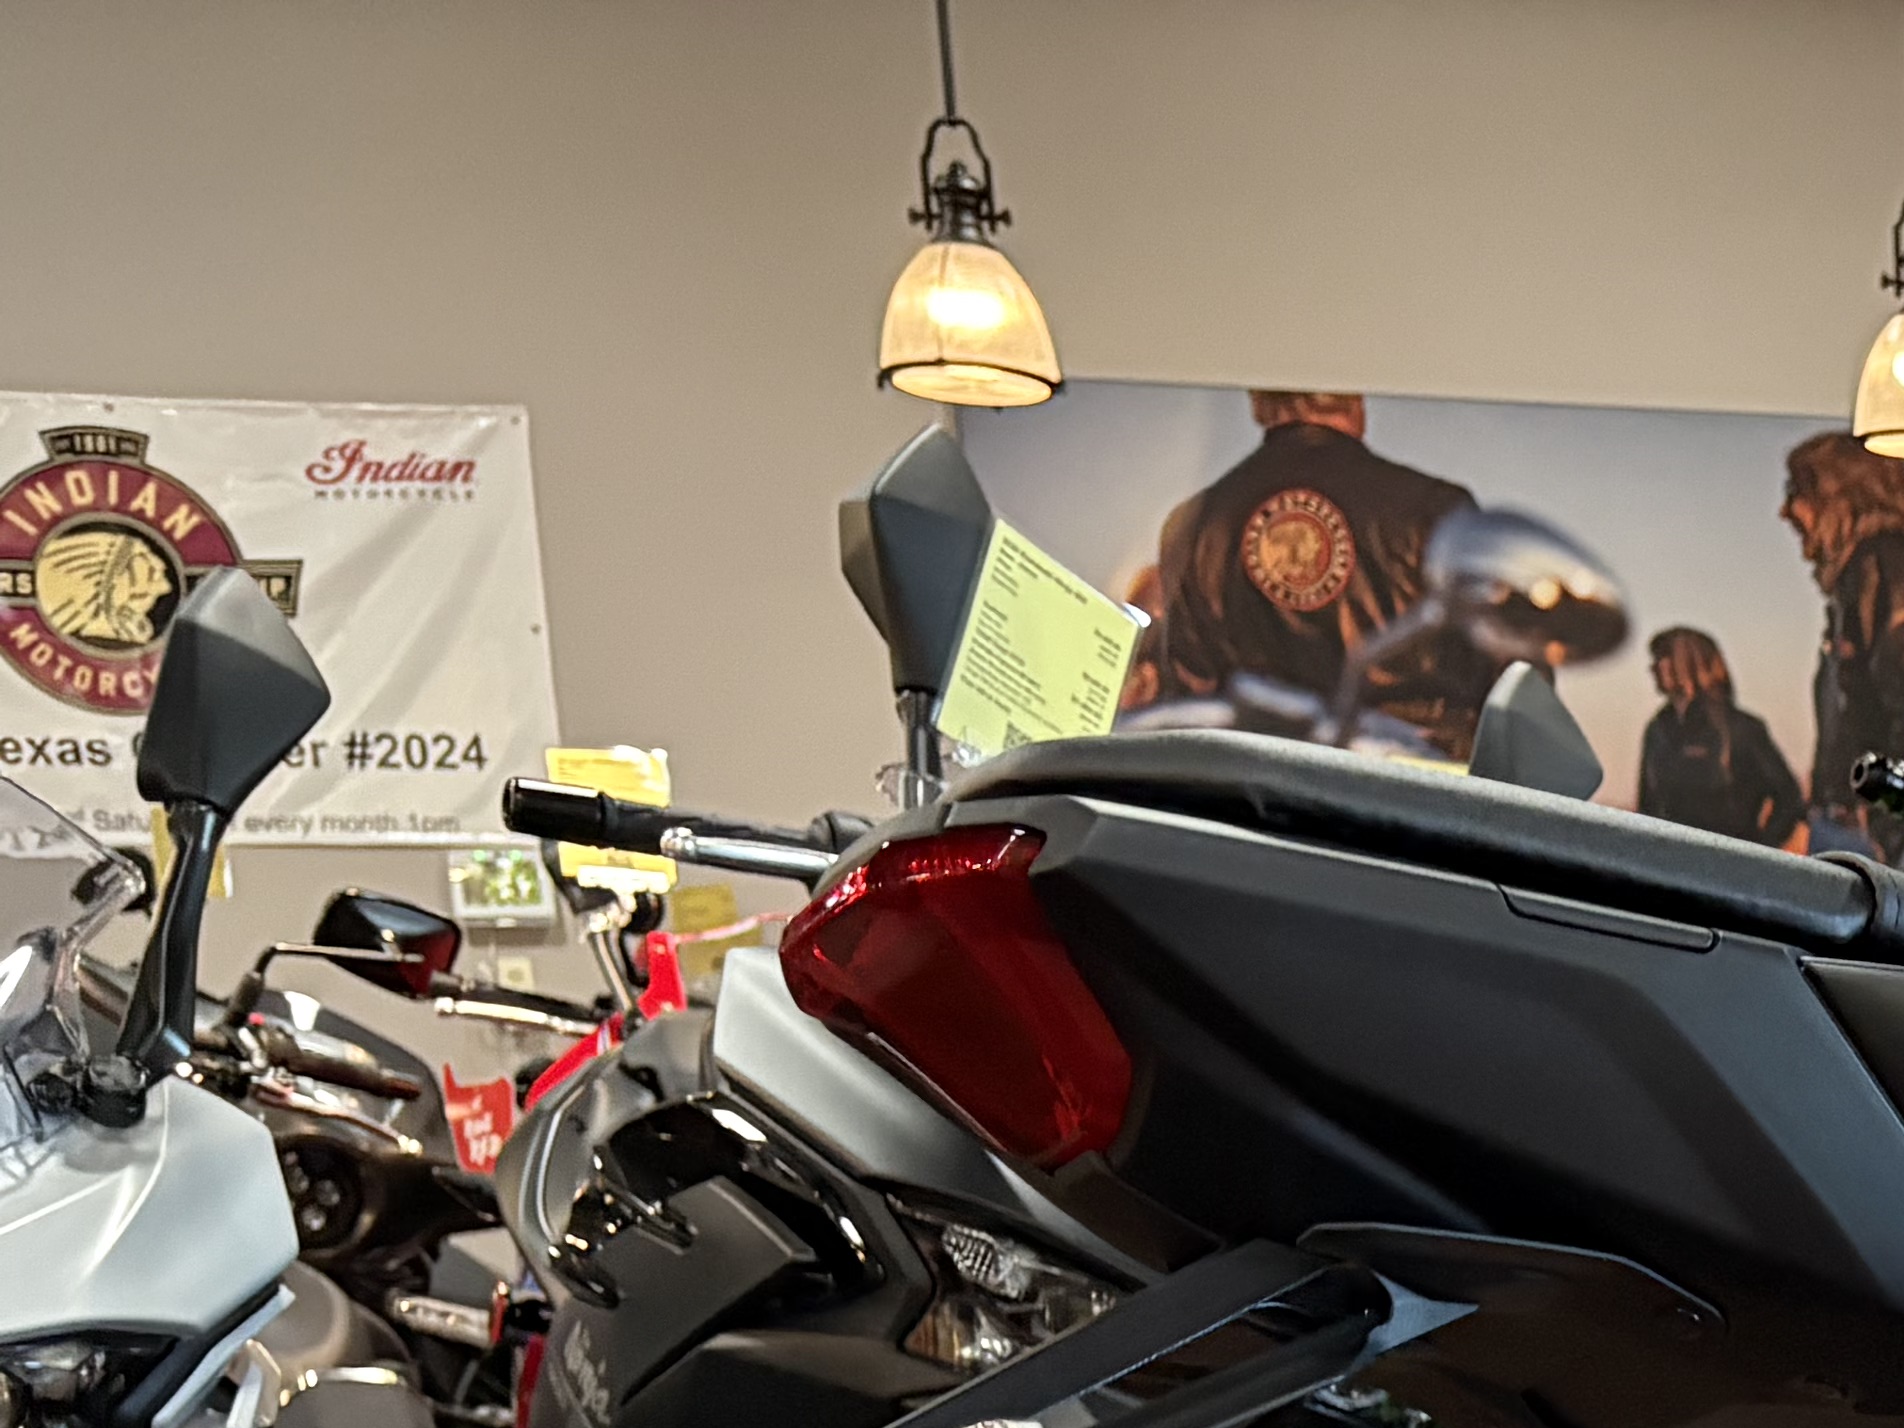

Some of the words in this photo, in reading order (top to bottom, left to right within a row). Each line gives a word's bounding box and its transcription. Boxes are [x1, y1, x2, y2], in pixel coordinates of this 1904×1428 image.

[305, 439, 476, 485] Indian
[3, 469, 202, 541] INDIAN
[344, 731, 488, 771] #2024
